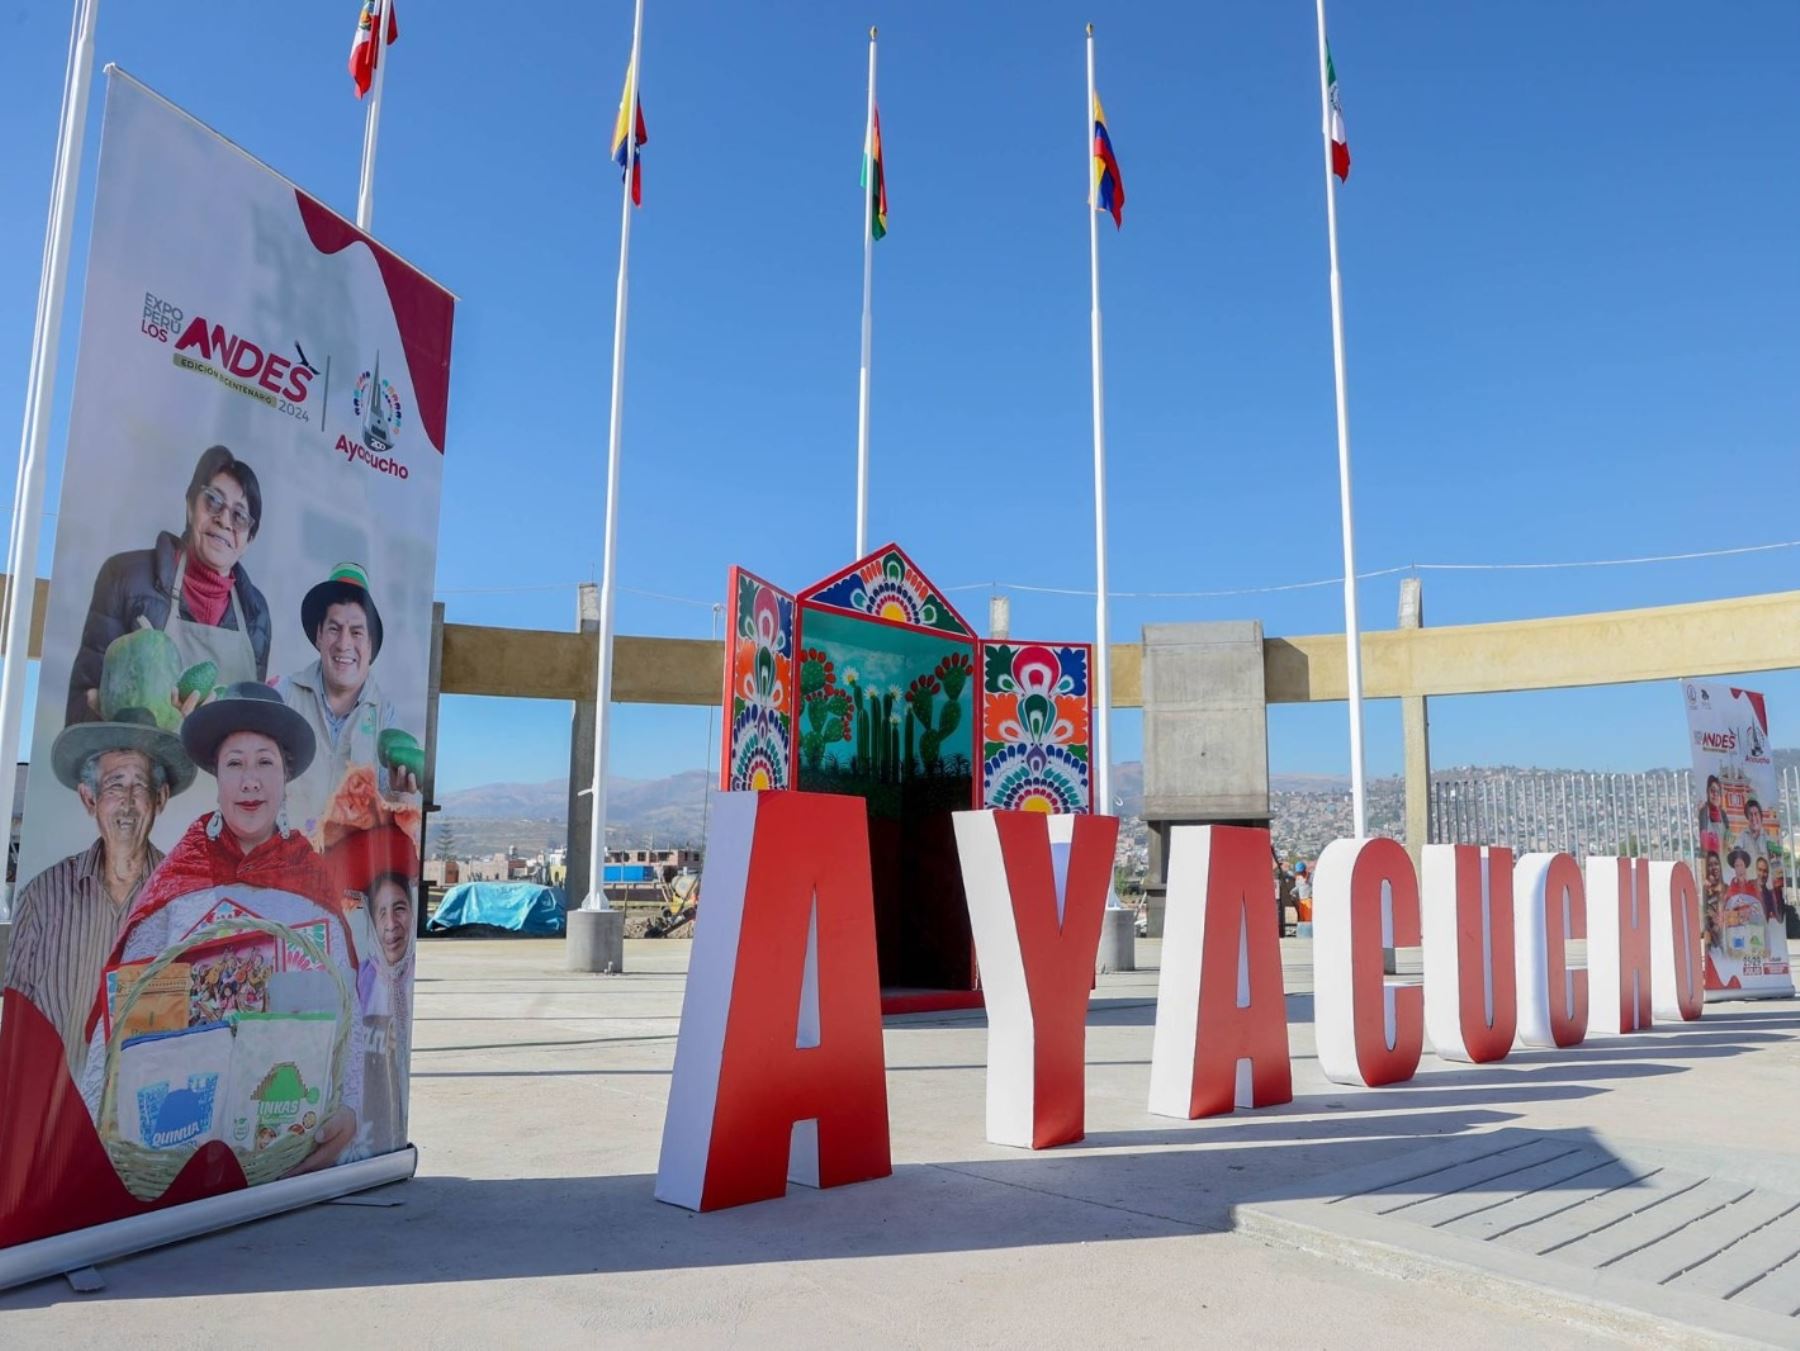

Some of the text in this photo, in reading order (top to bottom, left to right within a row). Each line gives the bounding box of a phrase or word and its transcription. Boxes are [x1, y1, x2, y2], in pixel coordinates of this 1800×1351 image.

[145, 292, 184, 321] EXPO
[141, 319, 168, 343] LOS
[174, 316, 314, 403] ANDES
[219, 374, 272, 404] CENTENARIO
[278, 399, 310, 422] 2024
[335, 434, 409, 479] Ayacucho
[655, 790, 1704, 1211] AYACUCHO
